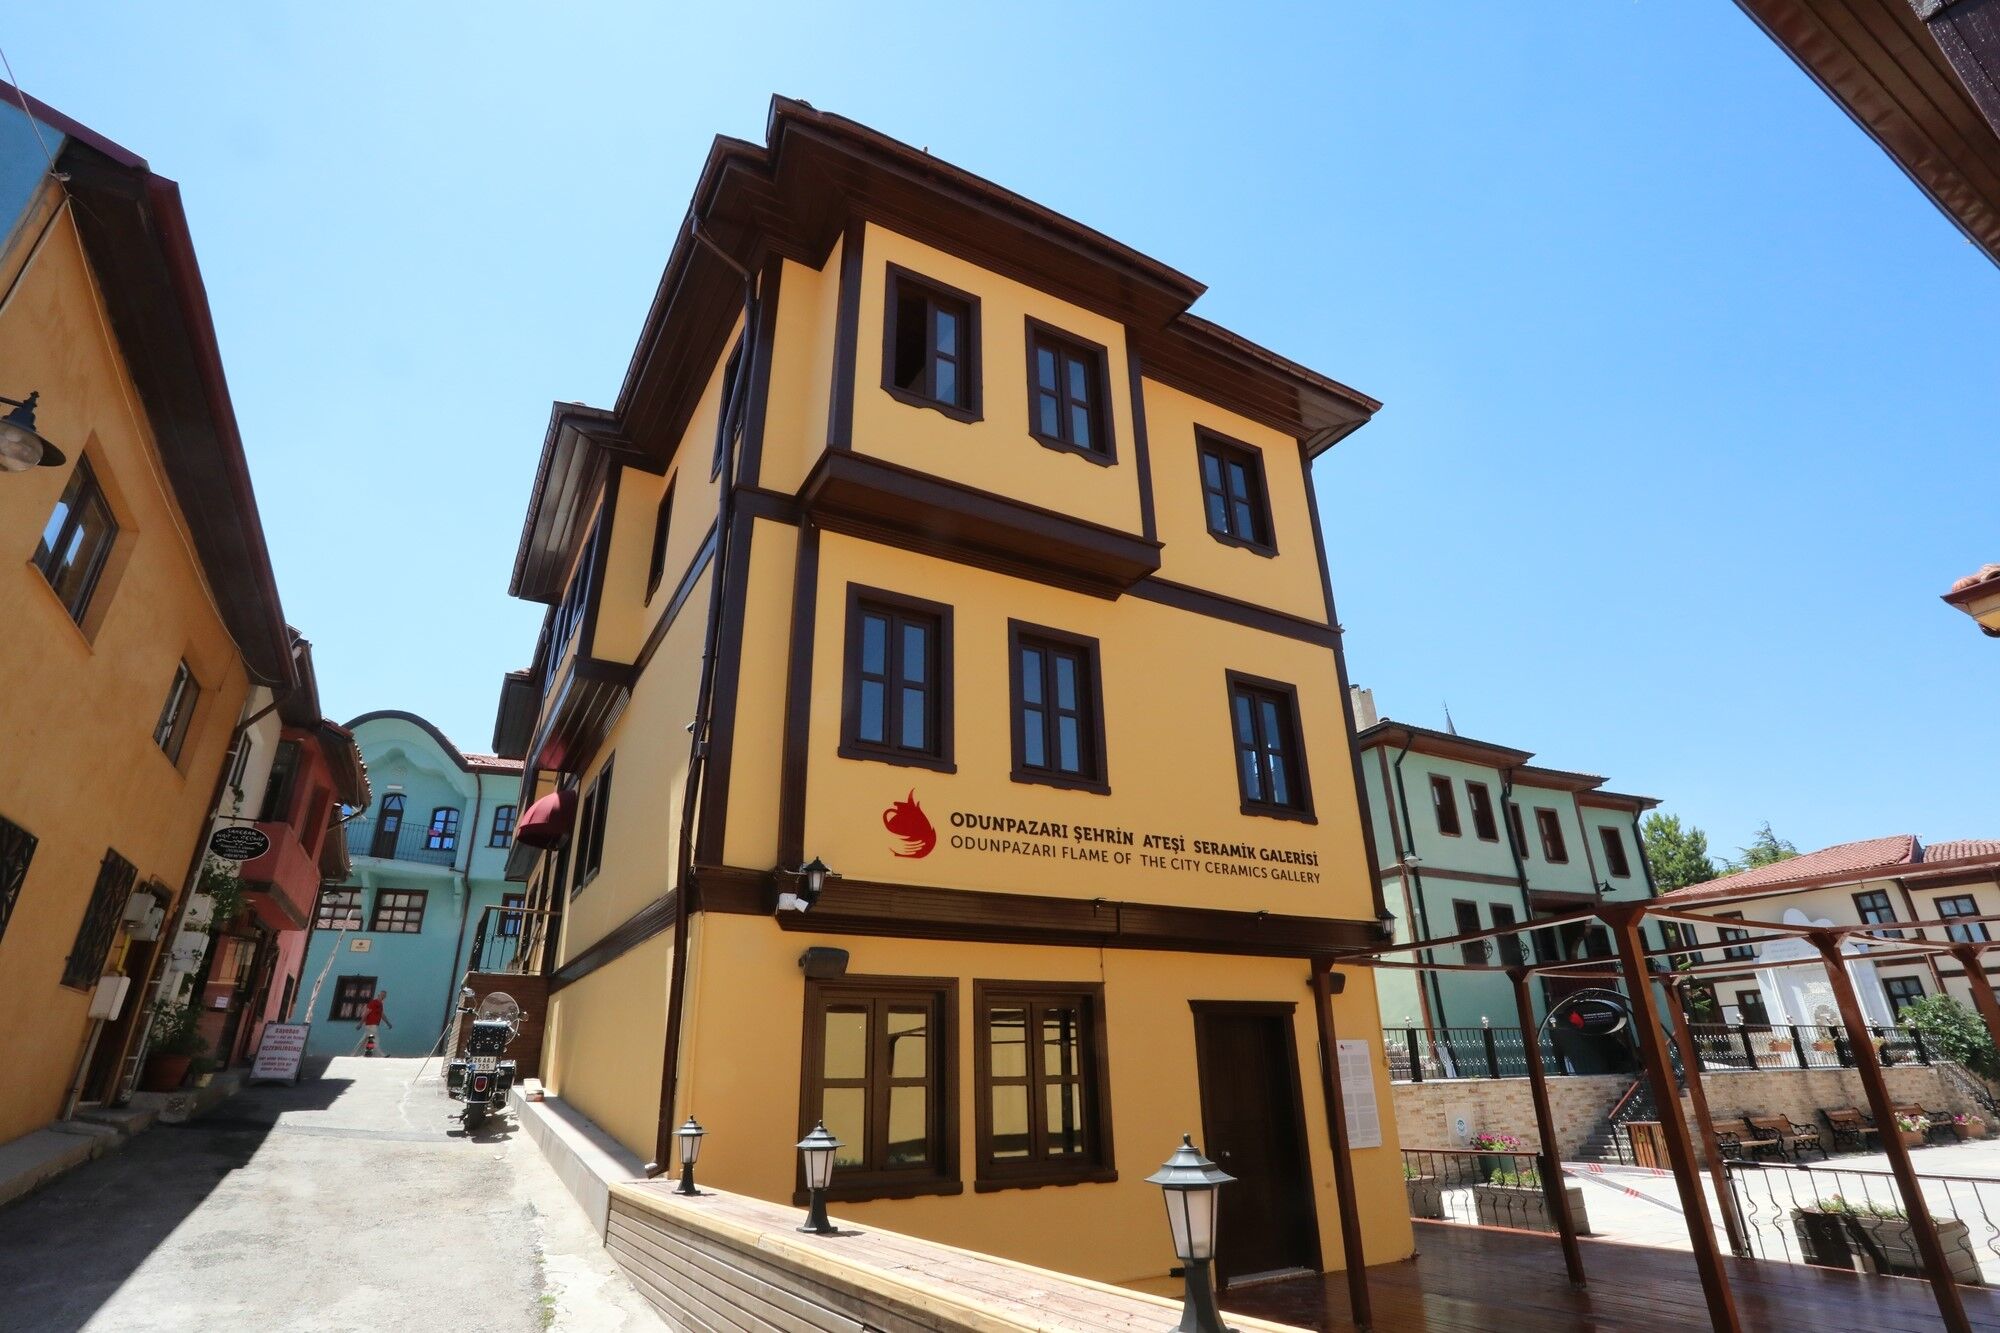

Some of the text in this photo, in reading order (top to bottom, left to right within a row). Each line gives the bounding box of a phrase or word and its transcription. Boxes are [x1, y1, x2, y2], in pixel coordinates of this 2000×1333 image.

[950, 811, 1319, 867] ODUNPAZARI ŞEHRİN ATEŞİ SERAMİK GALERİSİ
[950, 834, 1321, 885] ODUNPAZARI FLAME OF THE CITY CERAMICS GALLERY
